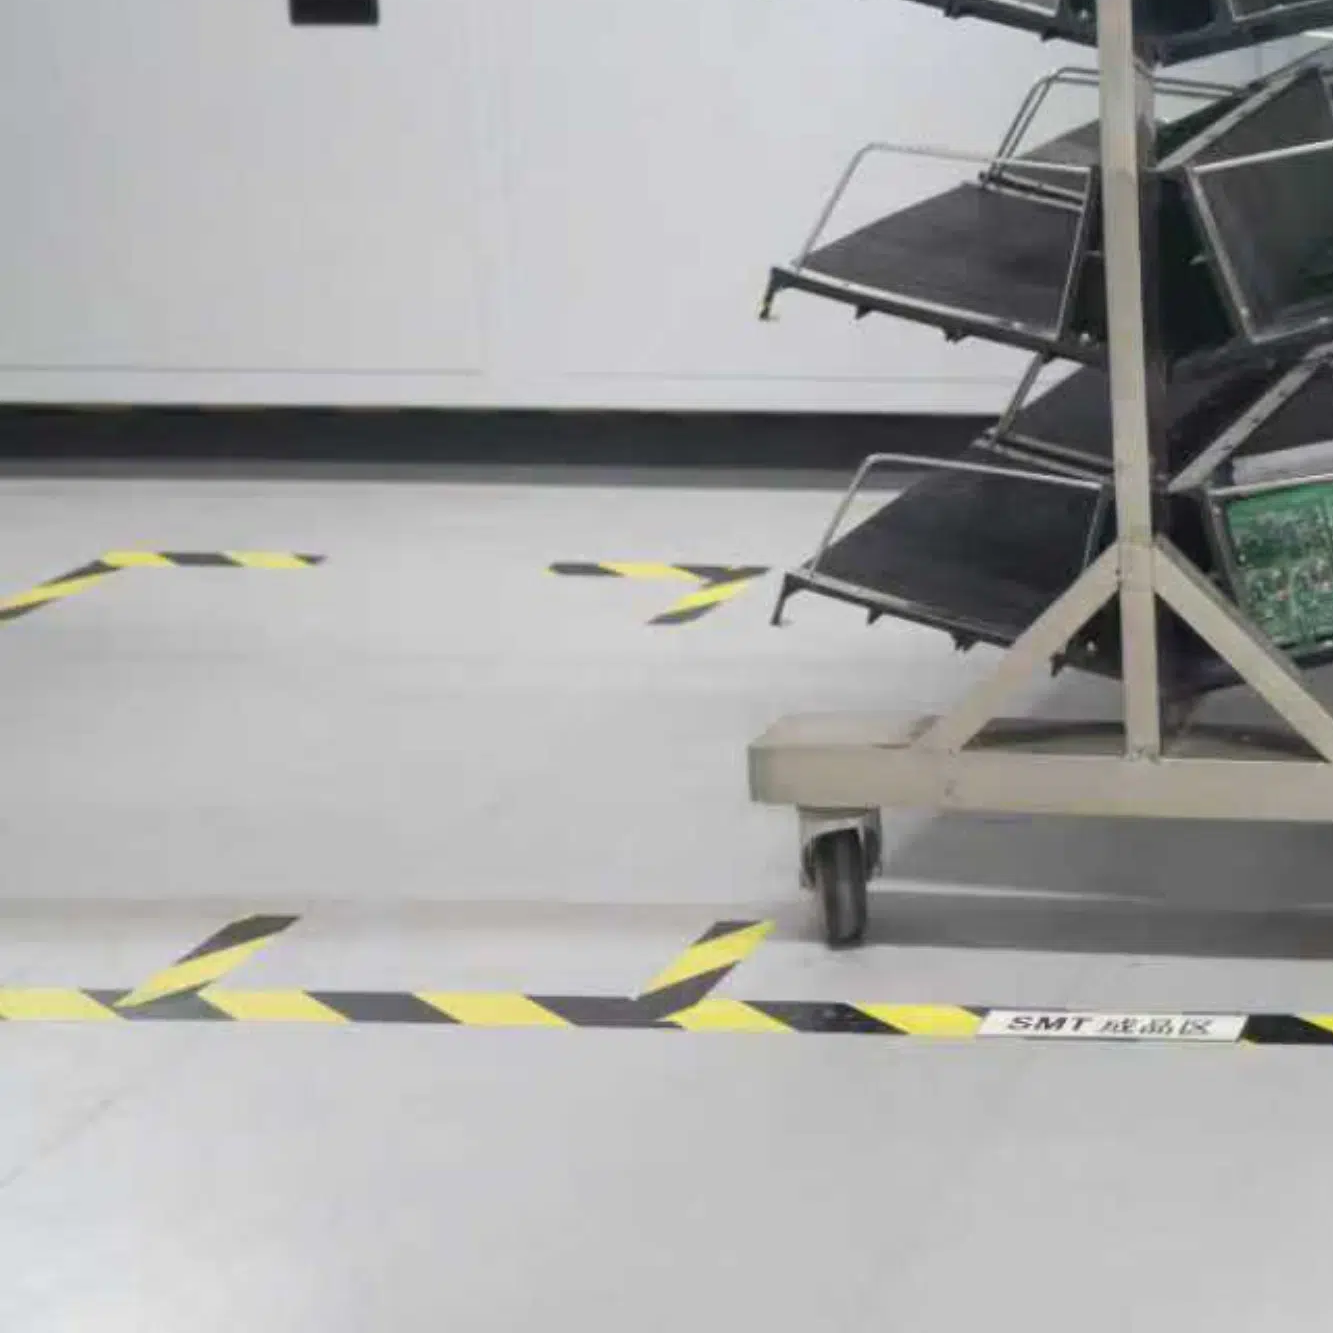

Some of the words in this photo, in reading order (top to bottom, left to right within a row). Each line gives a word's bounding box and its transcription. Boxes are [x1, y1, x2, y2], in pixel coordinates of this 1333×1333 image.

[1008, 1016, 1089, 1032] SMT
[1099, 1018, 1213, 1036] 成品区
